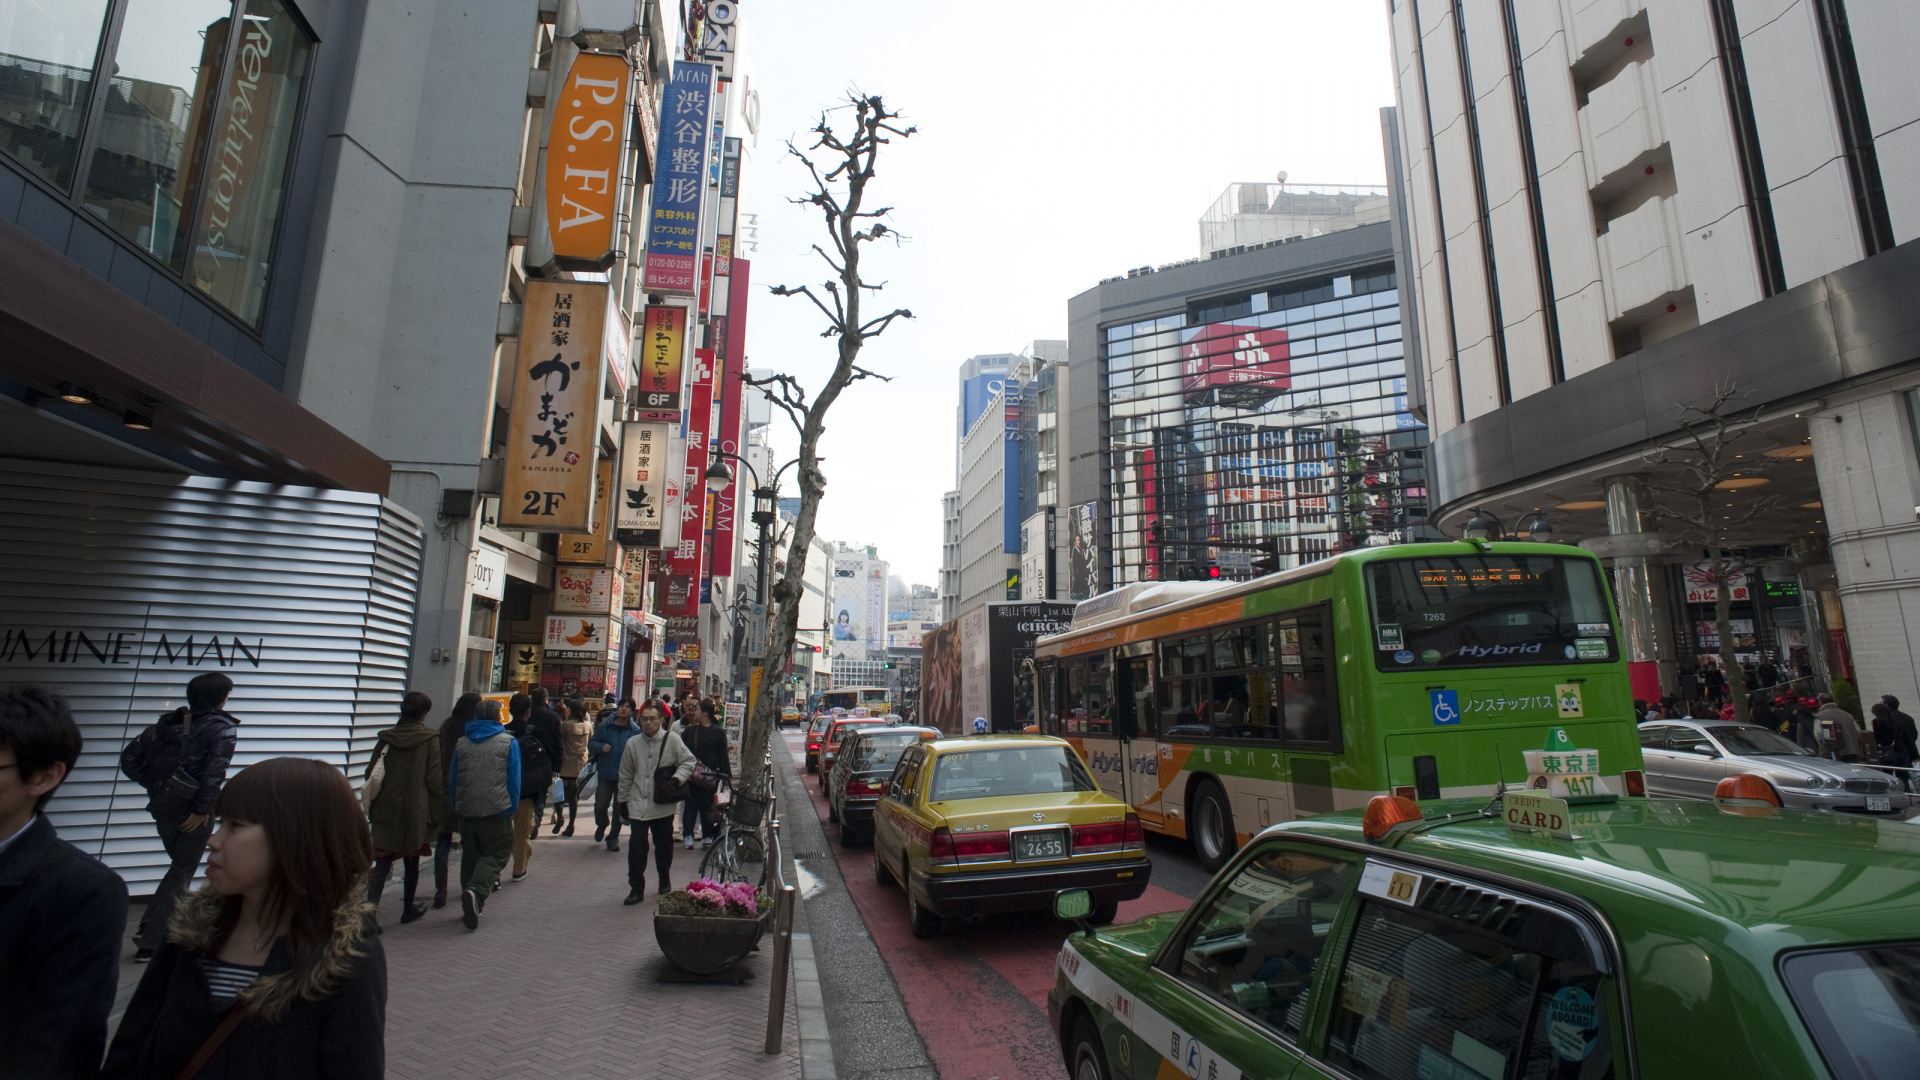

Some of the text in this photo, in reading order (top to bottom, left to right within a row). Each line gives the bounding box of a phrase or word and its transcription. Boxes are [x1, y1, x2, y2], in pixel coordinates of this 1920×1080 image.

[559, 74, 618, 233] P.S.FA
[666, 89, 706, 204] 渋谷整形
[723, 161, 735, 194] 岩本ビル
[654, 209, 696, 221] 美容外科
[654, 225, 695, 236] ピアス穴あけ
[652, 239, 693, 250] レーザー脱毛
[649, 257, 692, 269] 0120-00-2266
[648, 274, 692, 286] 当ビル3F
[550, 292, 574, 346] 居酒家
[529, 353, 581, 459] かまどか
[648, 394, 670, 405] 6F
[1005, 380, 1020, 441] SEIBU
[637, 430, 652, 468] 居酒家
[521, 465, 572, 473] kamadoka
[522, 490, 566, 516] 2F
[716, 488, 733, 531] JAM
[573, 542, 593, 554] 2F
[998, 606, 1041, 617] 栗山千明
[1048, 608, 1059, 616] 1st
[1080, 598, 1106, 613] Hybrid
[667, 615, 698, 628] カラオケ
[1423, 613, 1446, 622] T262
[667, 629, 696, 638] Dining
[152, 633, 264, 668] MAN
[546, 650, 560, 658] B1F
[1458, 643, 1542, 658] Hybrid
[1463, 696, 1554, 713] ノンステップバス
[1557, 729, 1568, 743] 6
[1091, 750, 1159, 776] Hybrid
[1563, 776, 1595, 796] 1417
[1508, 796, 1542, 808] CREDIT
[1872, 802, 1889, 810] 51-22
[1508, 808, 1563, 831] CARD
[1042, 833, 1053, 841] 500
[1027, 840, 1062, 856] 26-55
[1551, 998, 1596, 1017] WELCOME
[1551, 1010, 1594, 1028] ABOARD!
